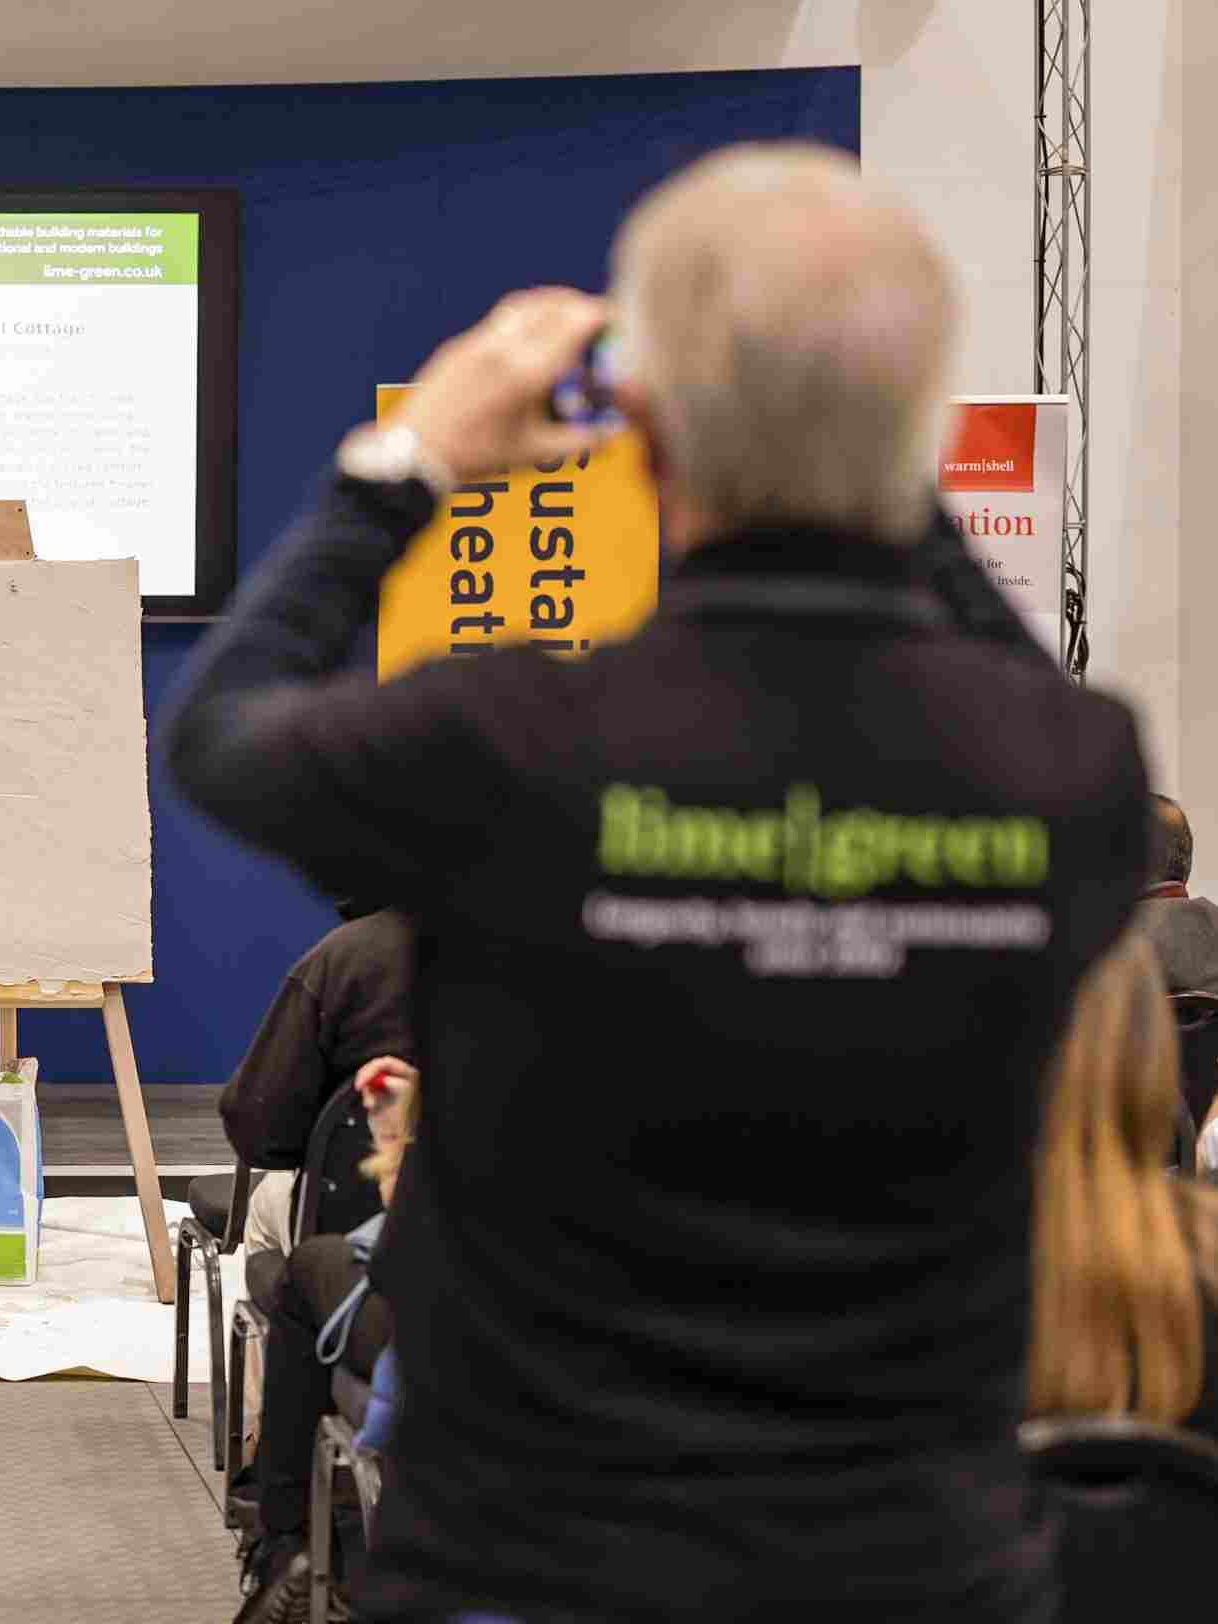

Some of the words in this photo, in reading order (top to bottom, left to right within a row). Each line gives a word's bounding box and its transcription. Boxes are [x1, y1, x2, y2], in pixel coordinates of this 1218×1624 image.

[36, 225, 84, 240] building
[87, 226, 142, 238] materials
[145, 225, 163, 238] for
[34, 242, 57, 254] and
[59, 243, 105, 254] modern
[108, 242, 163, 256] buildings
[13, 321, 86, 337] Cottage
[987, 558, 1005, 569] for
